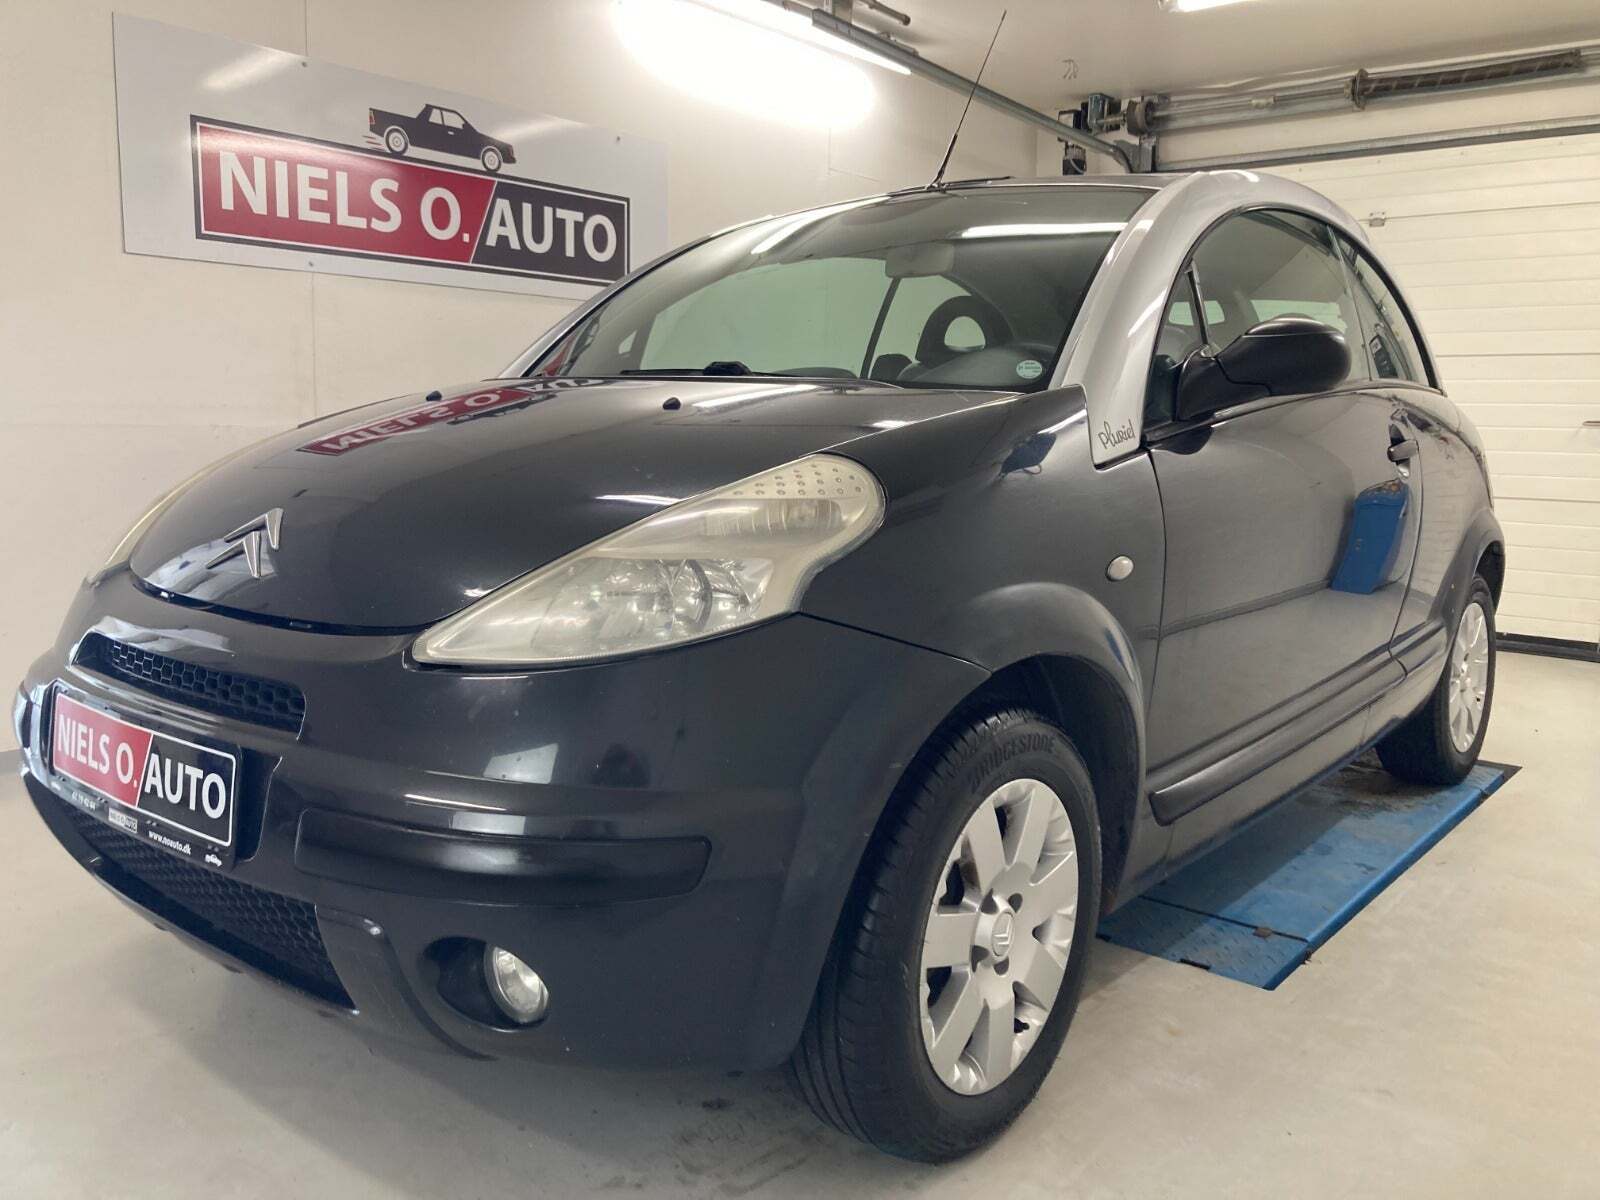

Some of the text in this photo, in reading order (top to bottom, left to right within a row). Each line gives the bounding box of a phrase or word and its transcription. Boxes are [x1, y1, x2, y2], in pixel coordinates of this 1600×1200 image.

[218, 151, 617, 262] NIELS O. AUTO
[57, 714, 226, 819] NIELS O. AUTO
[968, 733, 1054, 794] BRIDGESTONE
[148, 830, 191, 855] www.noauto.dk
